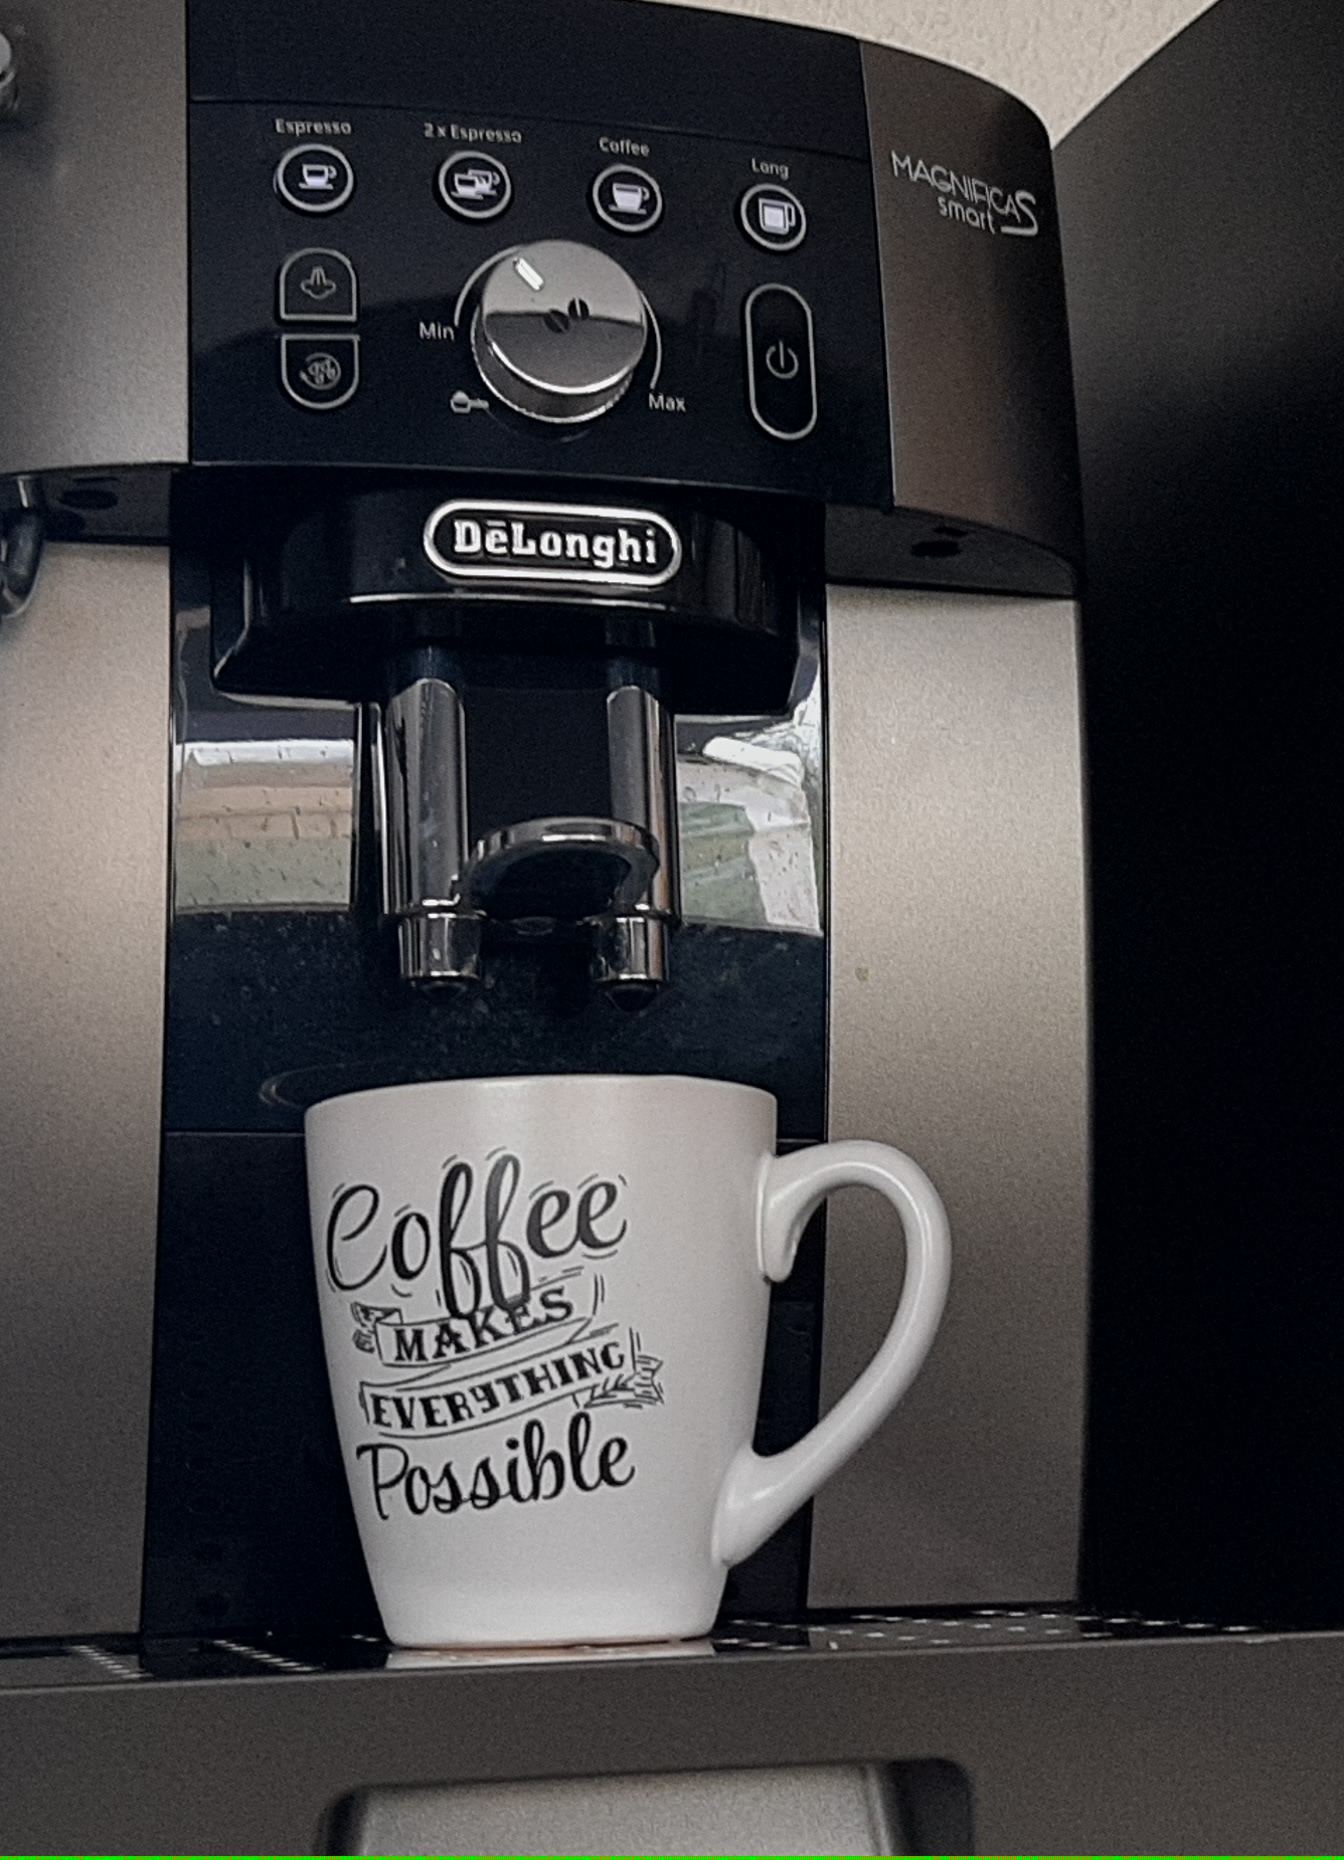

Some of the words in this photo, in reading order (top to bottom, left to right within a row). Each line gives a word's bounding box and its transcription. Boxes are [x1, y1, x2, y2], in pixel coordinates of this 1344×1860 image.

[275, 117, 352, 137] Espresso
[424, 123, 434, 138] 2
[451, 124, 522, 143] Espresso
[599, 137, 650, 156] Coffee
[751, 157, 789, 180] Long
[938, 196, 996, 234] smart
[419, 321, 455, 341] Min
[648, 393, 687, 412] Max
[326, 1153, 628, 1320] Coffee
[393, 1286, 574, 1363] MAKES
[369, 1340, 626, 1430] EVERYTHING
[356, 1411, 636, 1521] Possible
